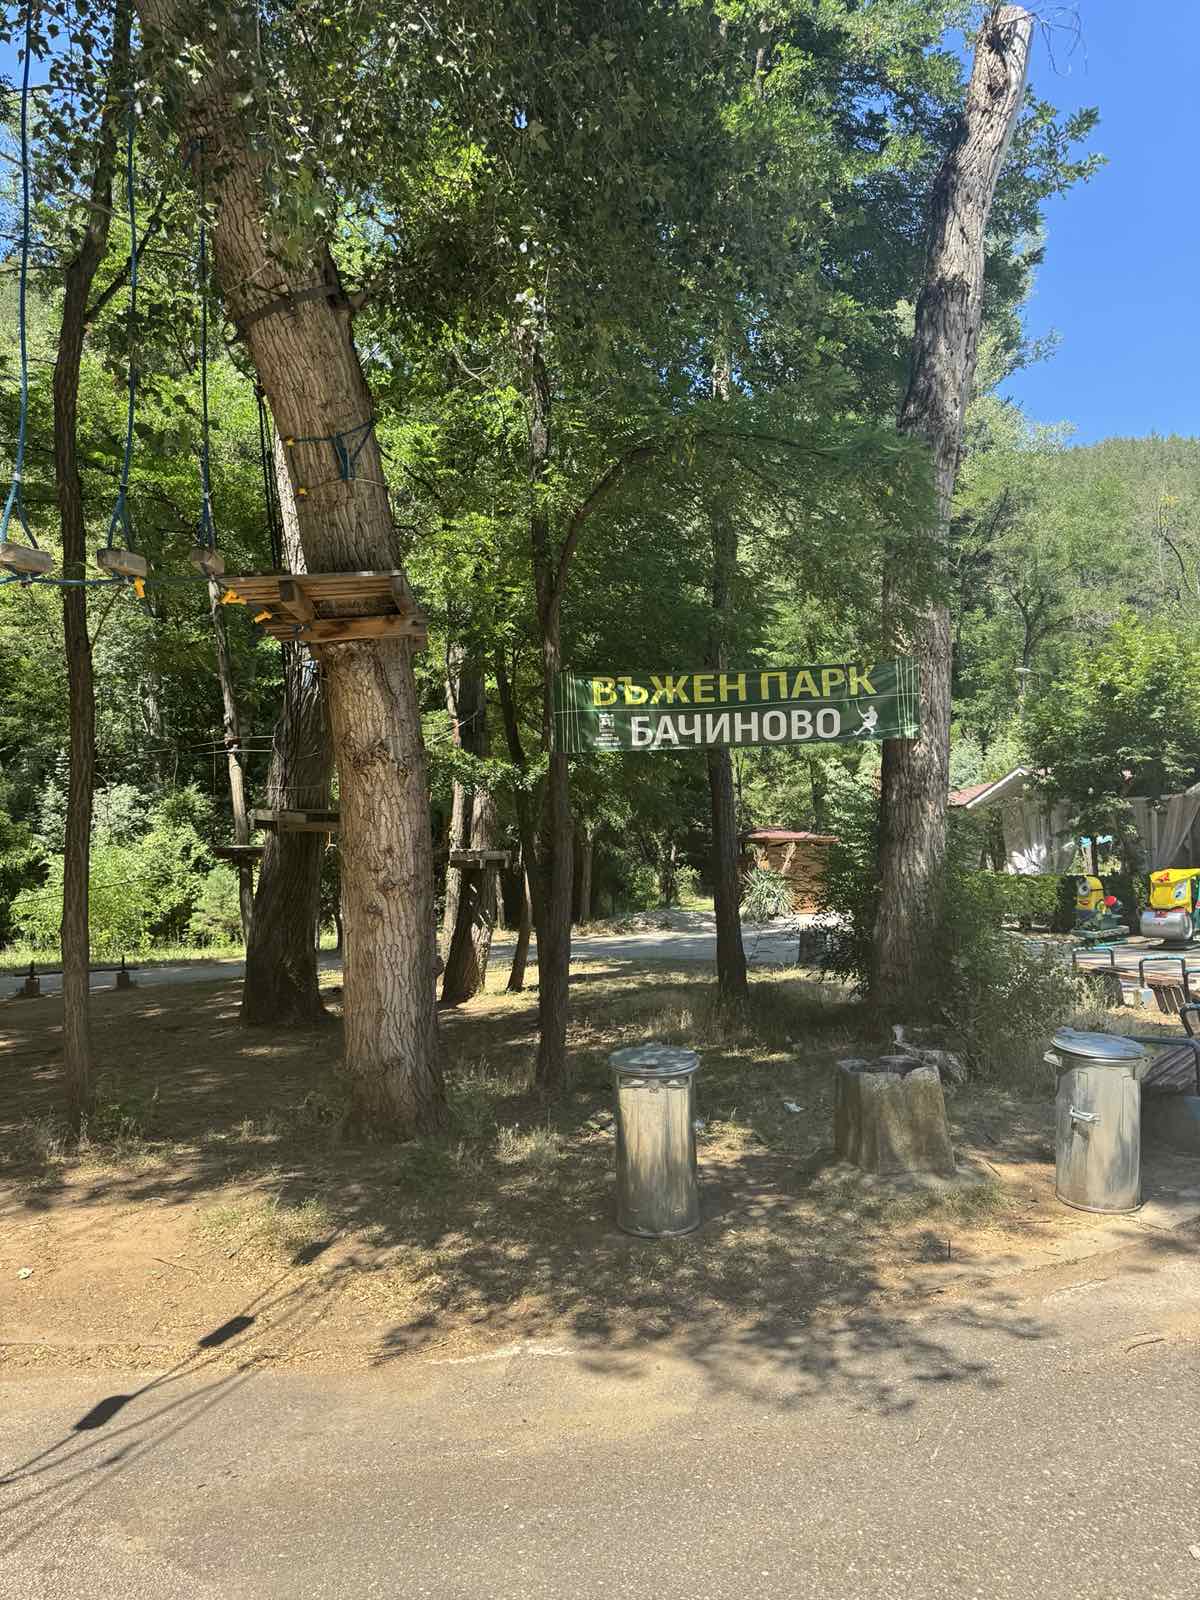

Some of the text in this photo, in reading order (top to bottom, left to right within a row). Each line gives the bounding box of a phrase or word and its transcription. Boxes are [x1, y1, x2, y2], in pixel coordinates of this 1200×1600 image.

[591, 665, 878, 706] ВЪЖЕН ПАРК
[630, 708, 841, 746] БАЧИНОВО
